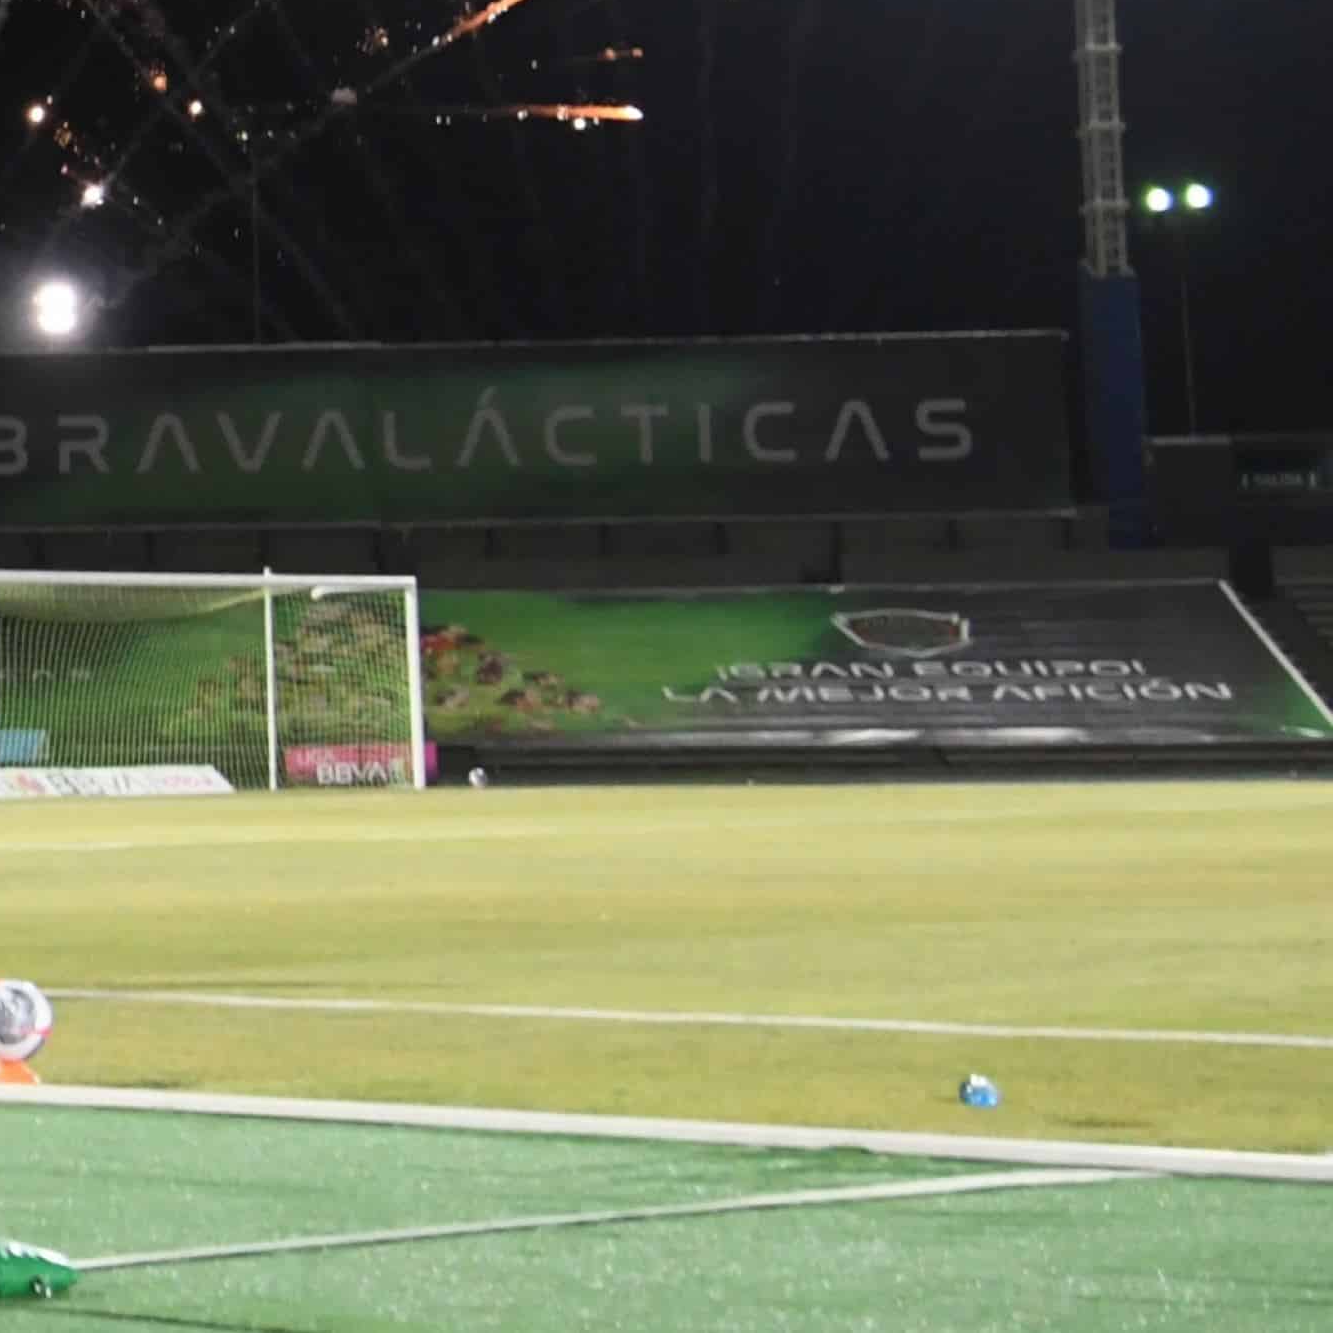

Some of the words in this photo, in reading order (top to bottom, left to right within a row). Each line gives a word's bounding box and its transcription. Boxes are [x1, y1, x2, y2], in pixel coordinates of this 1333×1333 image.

[660, 684, 738, 703] LA
[756, 683, 970, 703] MEJOR
[991, 677, 1233, 701] AFICIÓN
